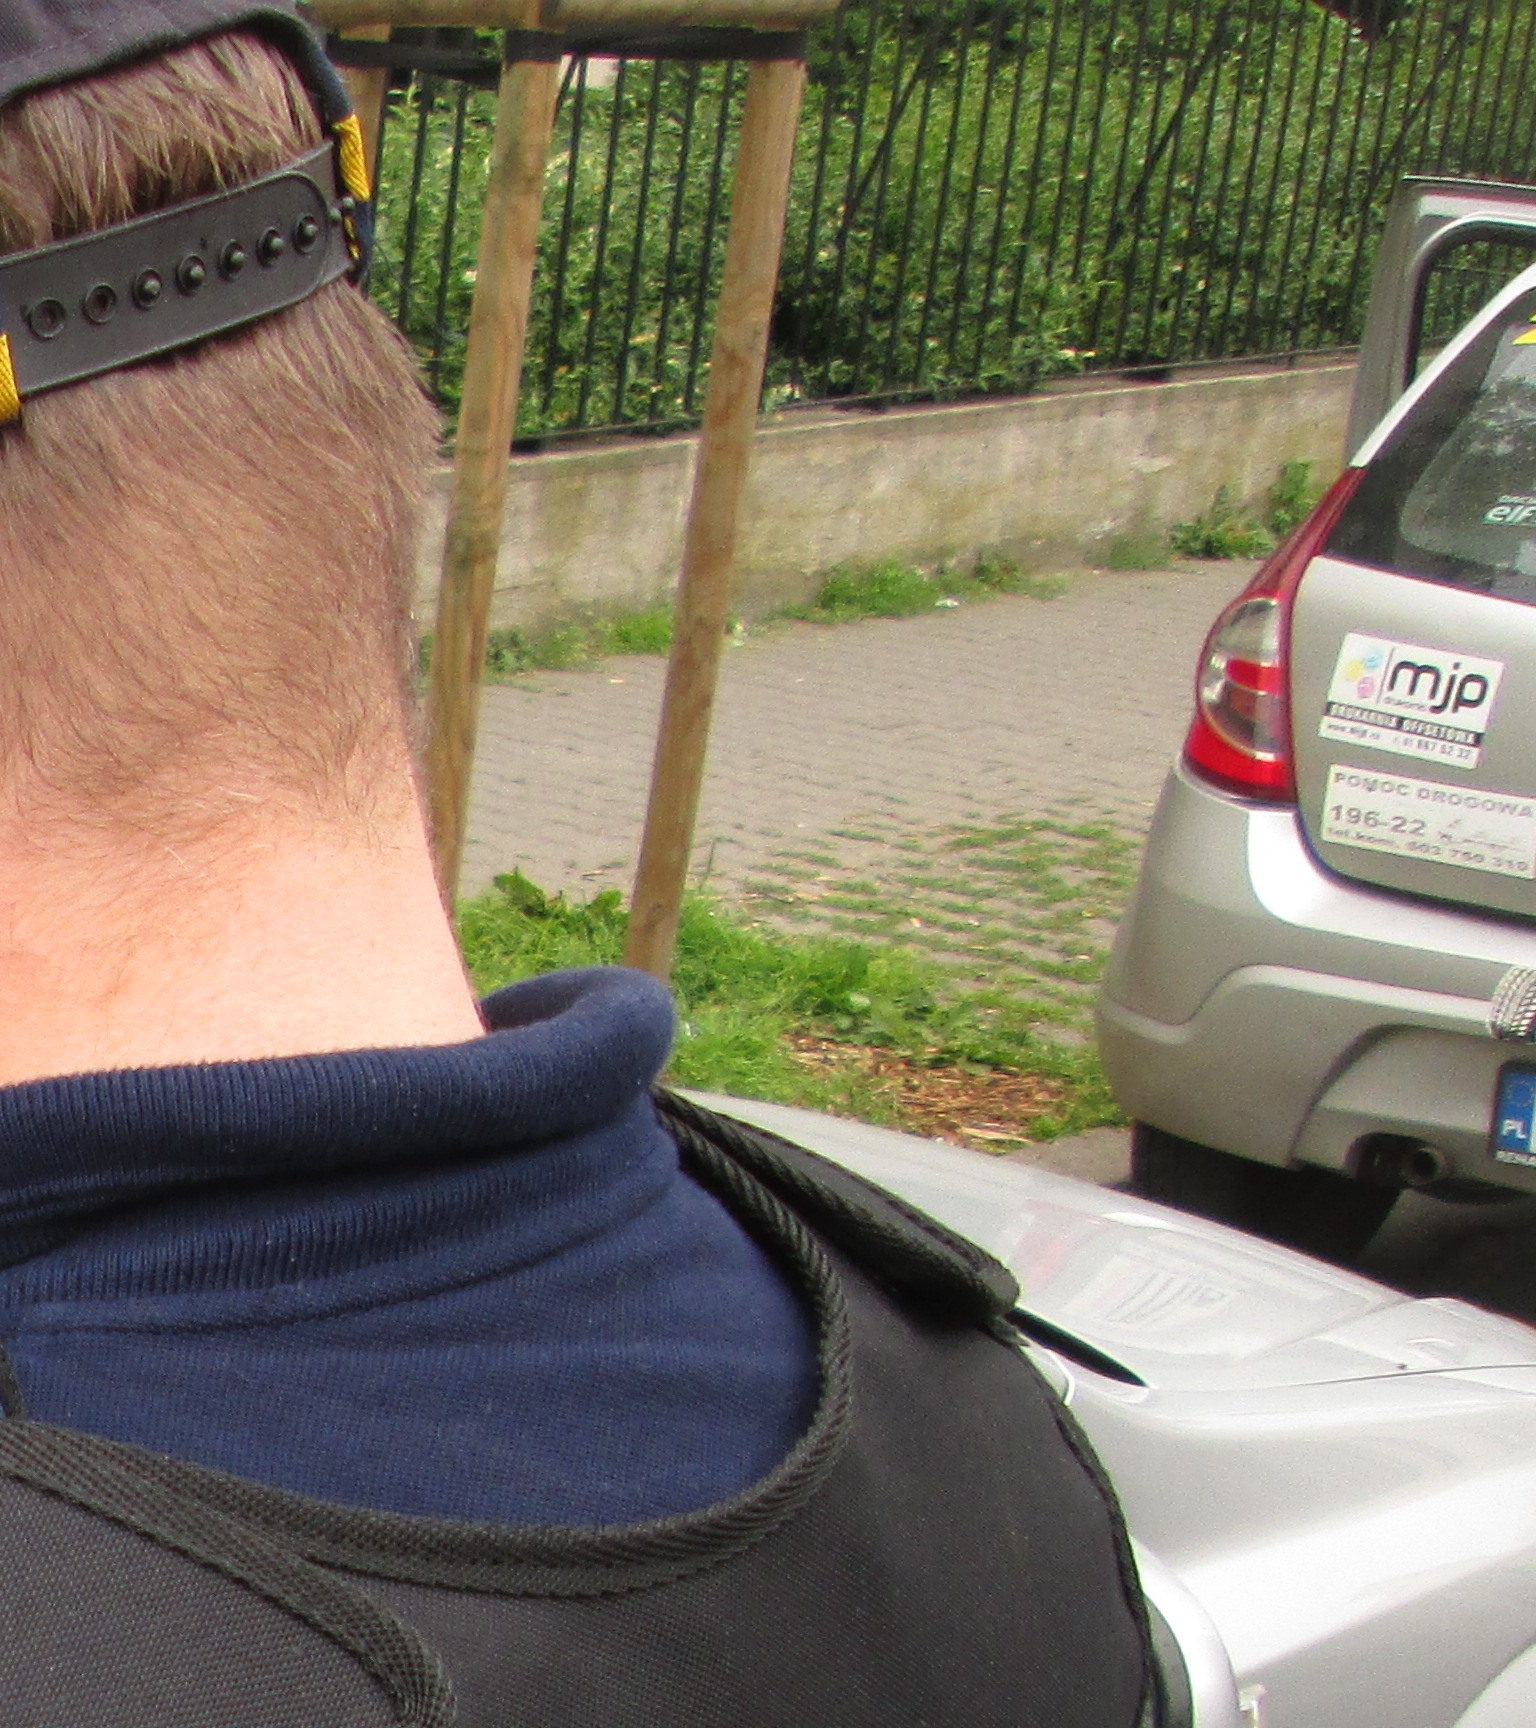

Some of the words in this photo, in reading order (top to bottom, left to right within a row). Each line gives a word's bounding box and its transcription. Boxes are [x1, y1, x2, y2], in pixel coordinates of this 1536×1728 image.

[1387, 660, 1489, 714] mjp
[1333, 772, 1410, 797] POMOC
[1416, 786, 1534, 818] DROGOWA
[1331, 804, 1427, 837] 196-22
[1502, 1119, 1528, 1139] PL
